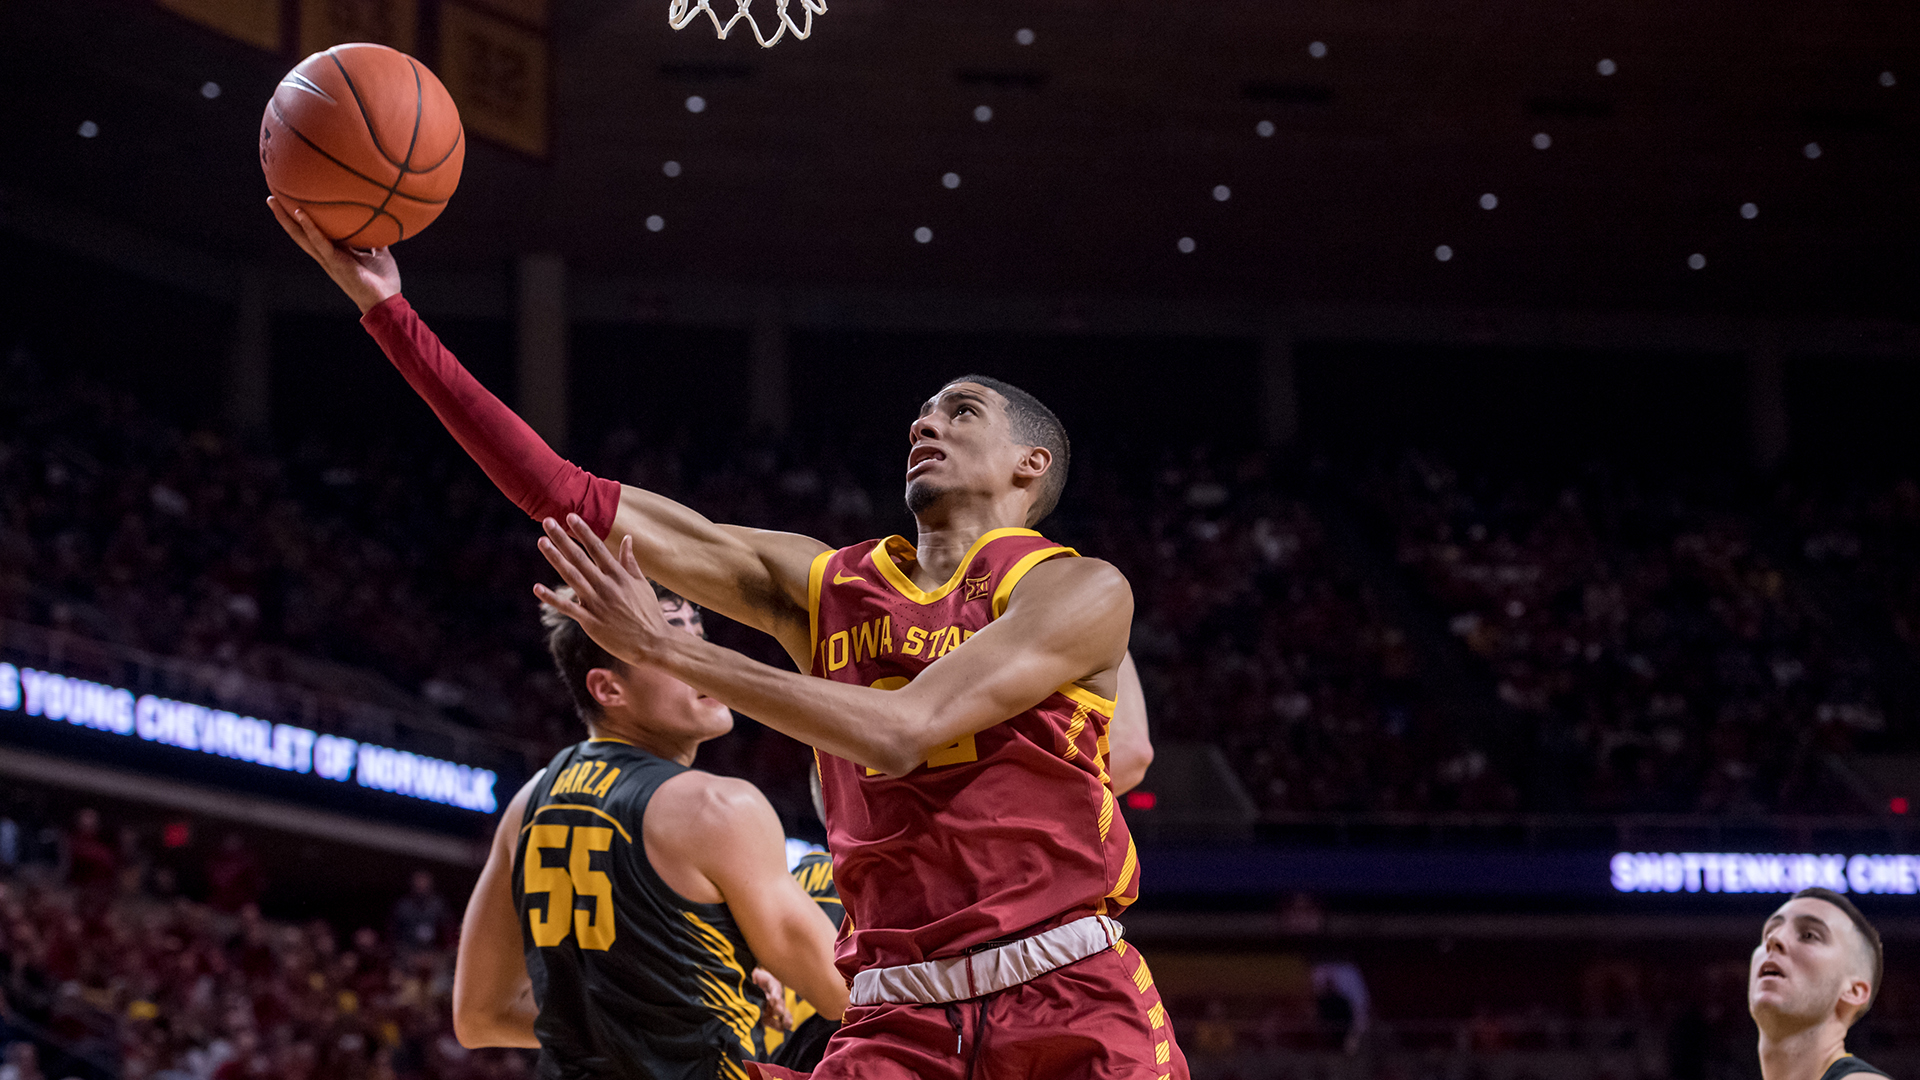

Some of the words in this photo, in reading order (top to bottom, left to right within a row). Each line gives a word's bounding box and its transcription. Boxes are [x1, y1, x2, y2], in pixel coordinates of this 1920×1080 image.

[820, 615, 893, 679] IOWA
[901, 625, 976, 660] STA
[21, 667, 136, 736] YOUNG
[136, 694, 317, 775] CHEVROLET
[313, 733, 358, 782] OF
[356, 742, 498, 814] NORWALK
[550, 760, 622, 798] GARZA
[523, 824, 617, 952] 55
[1847, 853, 1920, 894] CHE
